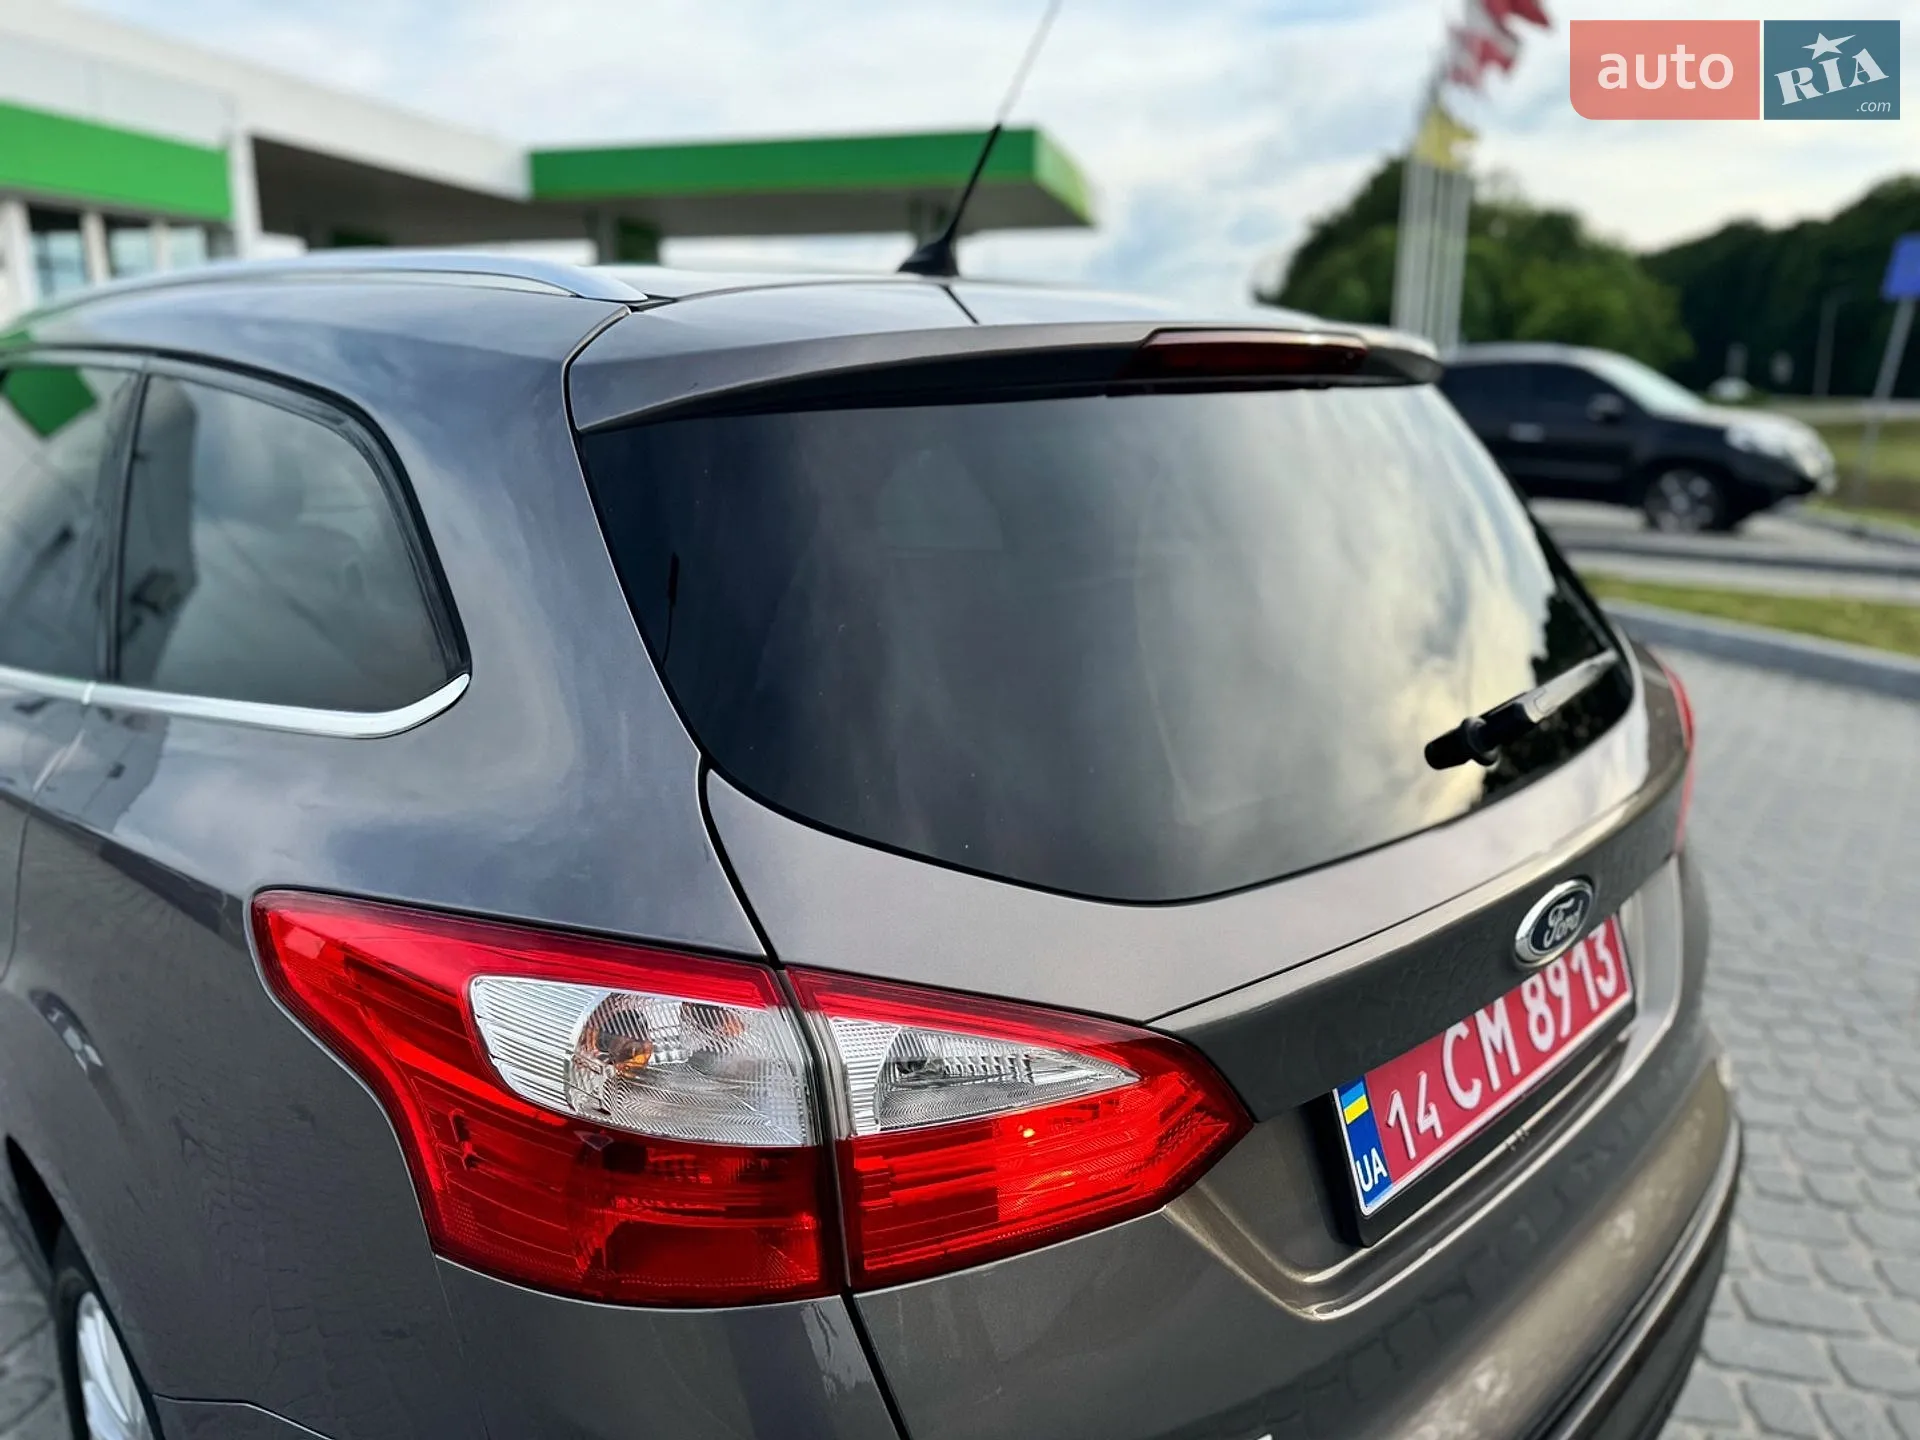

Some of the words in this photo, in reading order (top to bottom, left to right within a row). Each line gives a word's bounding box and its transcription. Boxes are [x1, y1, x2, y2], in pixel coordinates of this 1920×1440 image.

[1543, 898, 1584, 948] Ford
[1386, 1070, 1444, 1161] 14
[1442, 996, 1521, 1111] CM
[1521, 924, 1618, 1053] 8913
[1355, 1147, 1388, 1193] UA
